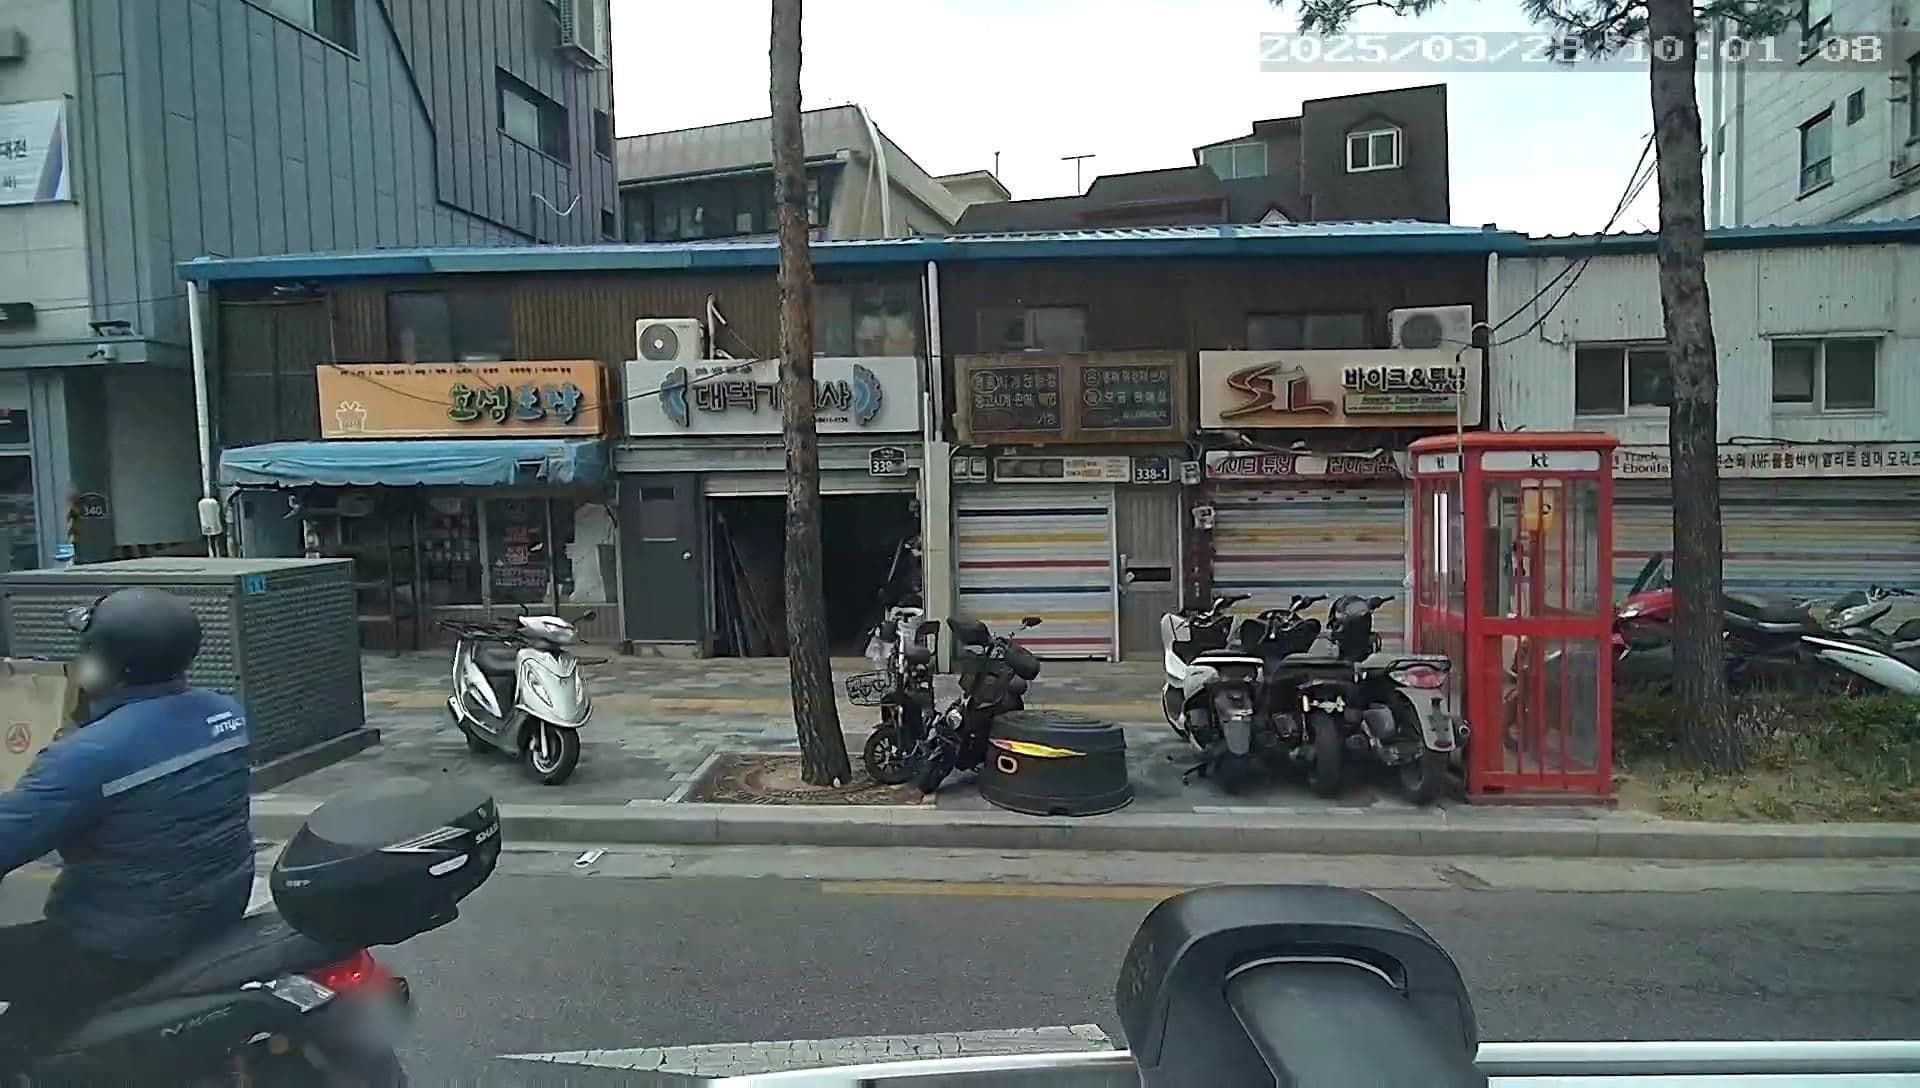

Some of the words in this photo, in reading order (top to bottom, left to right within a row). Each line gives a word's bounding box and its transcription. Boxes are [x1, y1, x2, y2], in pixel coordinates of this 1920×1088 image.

[1342, 367, 1466, 393] 바이크&튜닝
[691, 380, 852, 414] 대덕기사
[1262, 456, 1292, 475] 튜닝
[1530, 453, 1549, 468] kt
[1136, 467, 1168, 481] 338-1
